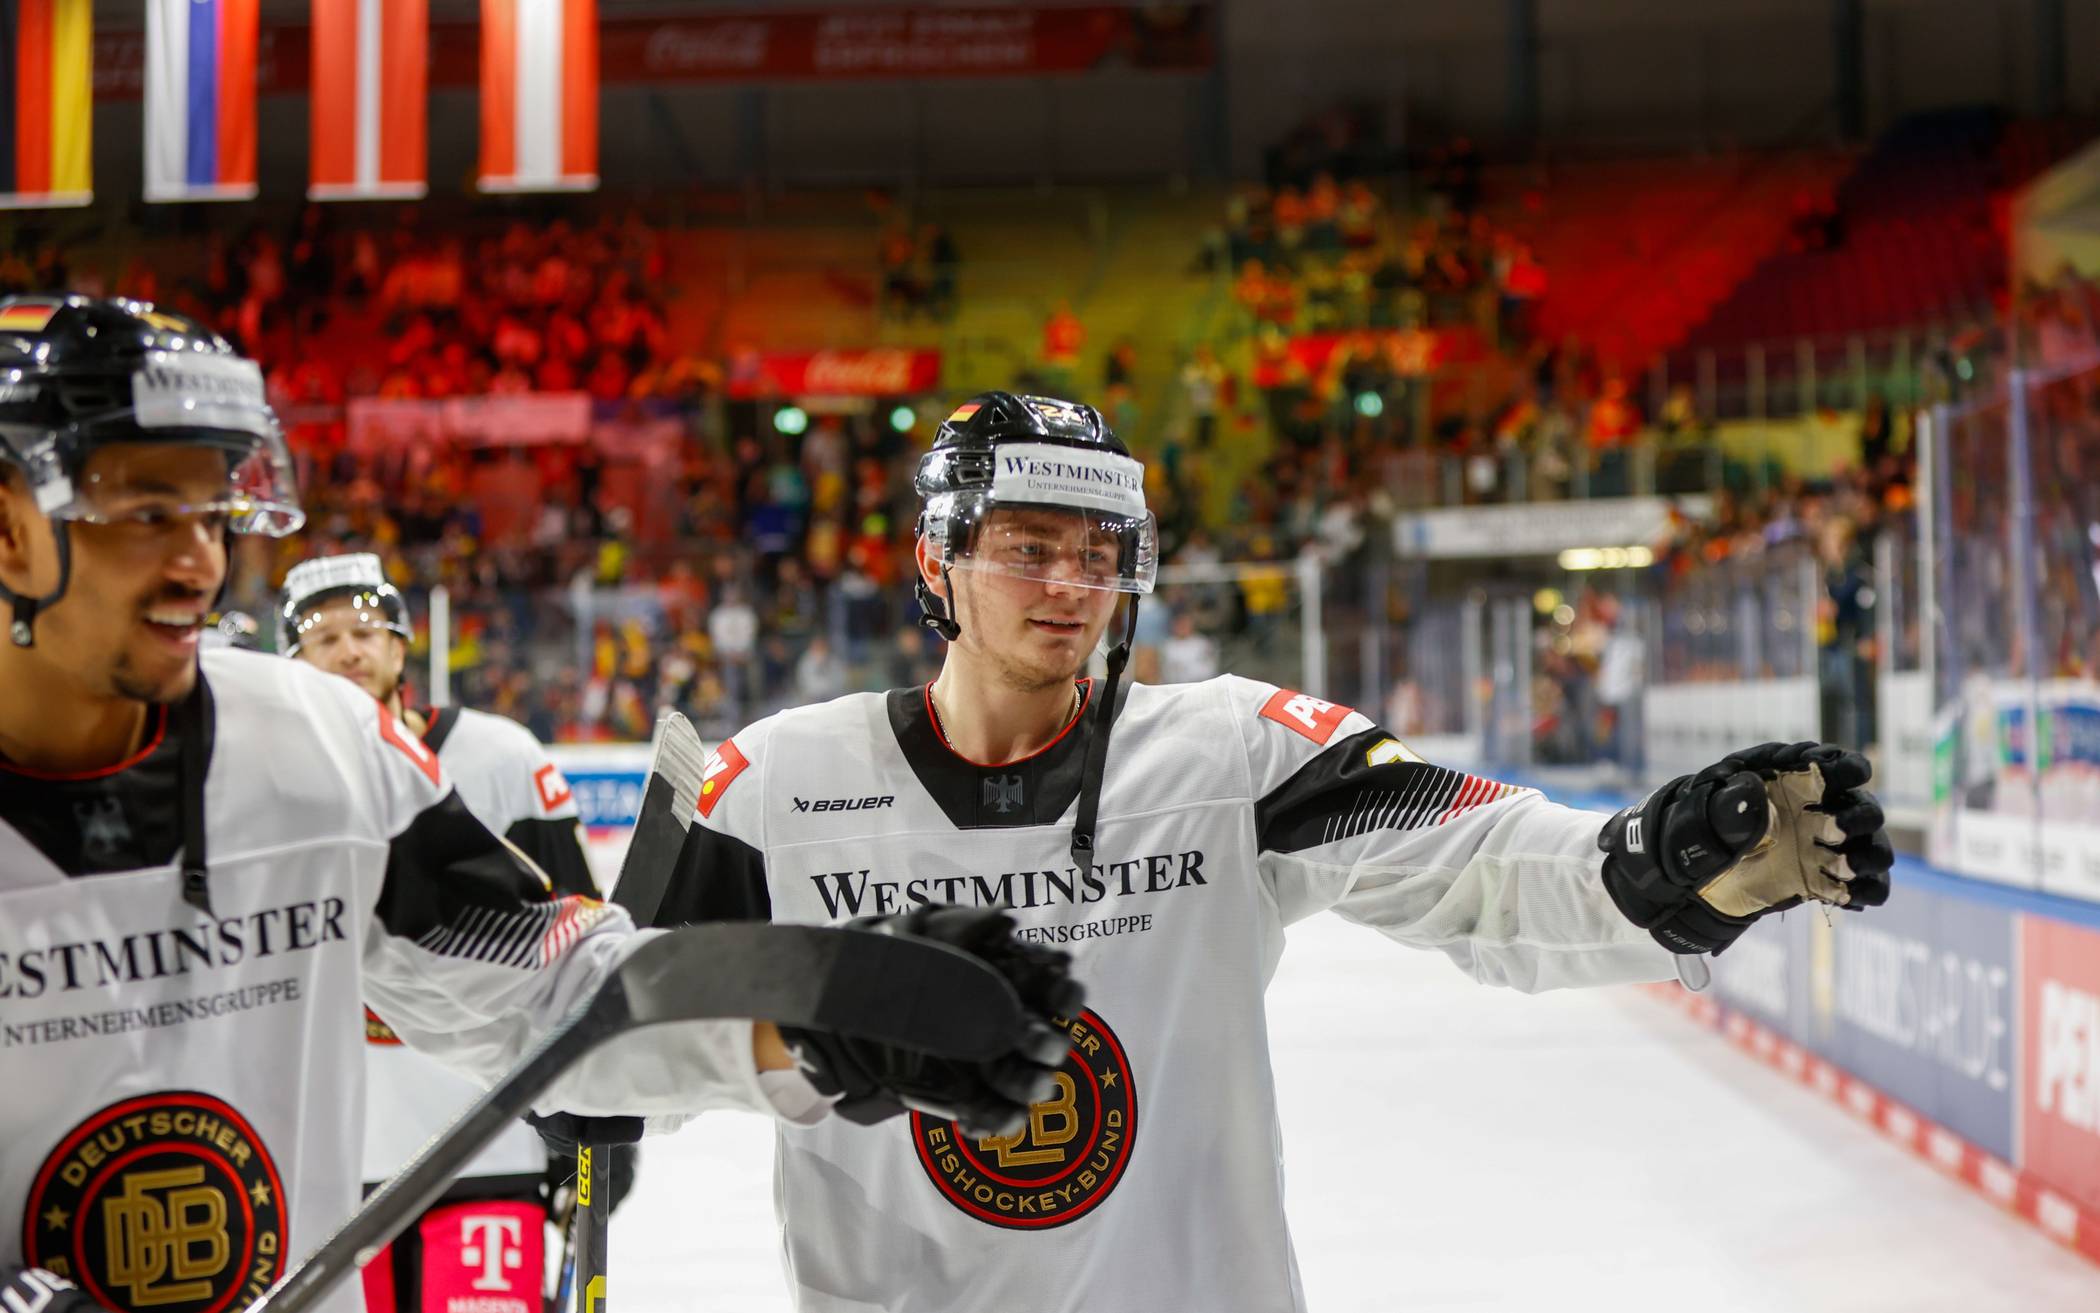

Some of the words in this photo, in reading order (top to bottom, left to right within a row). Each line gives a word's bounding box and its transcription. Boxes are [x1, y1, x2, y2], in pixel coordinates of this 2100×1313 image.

[1004, 455, 1139, 493] WESTMINSTER
[810, 850, 1208, 921] WESTMINSTER
[60, 1110, 252, 1188] DEUTSCHER
[927, 1108, 1123, 1214] EISHOCKEY-BUND
